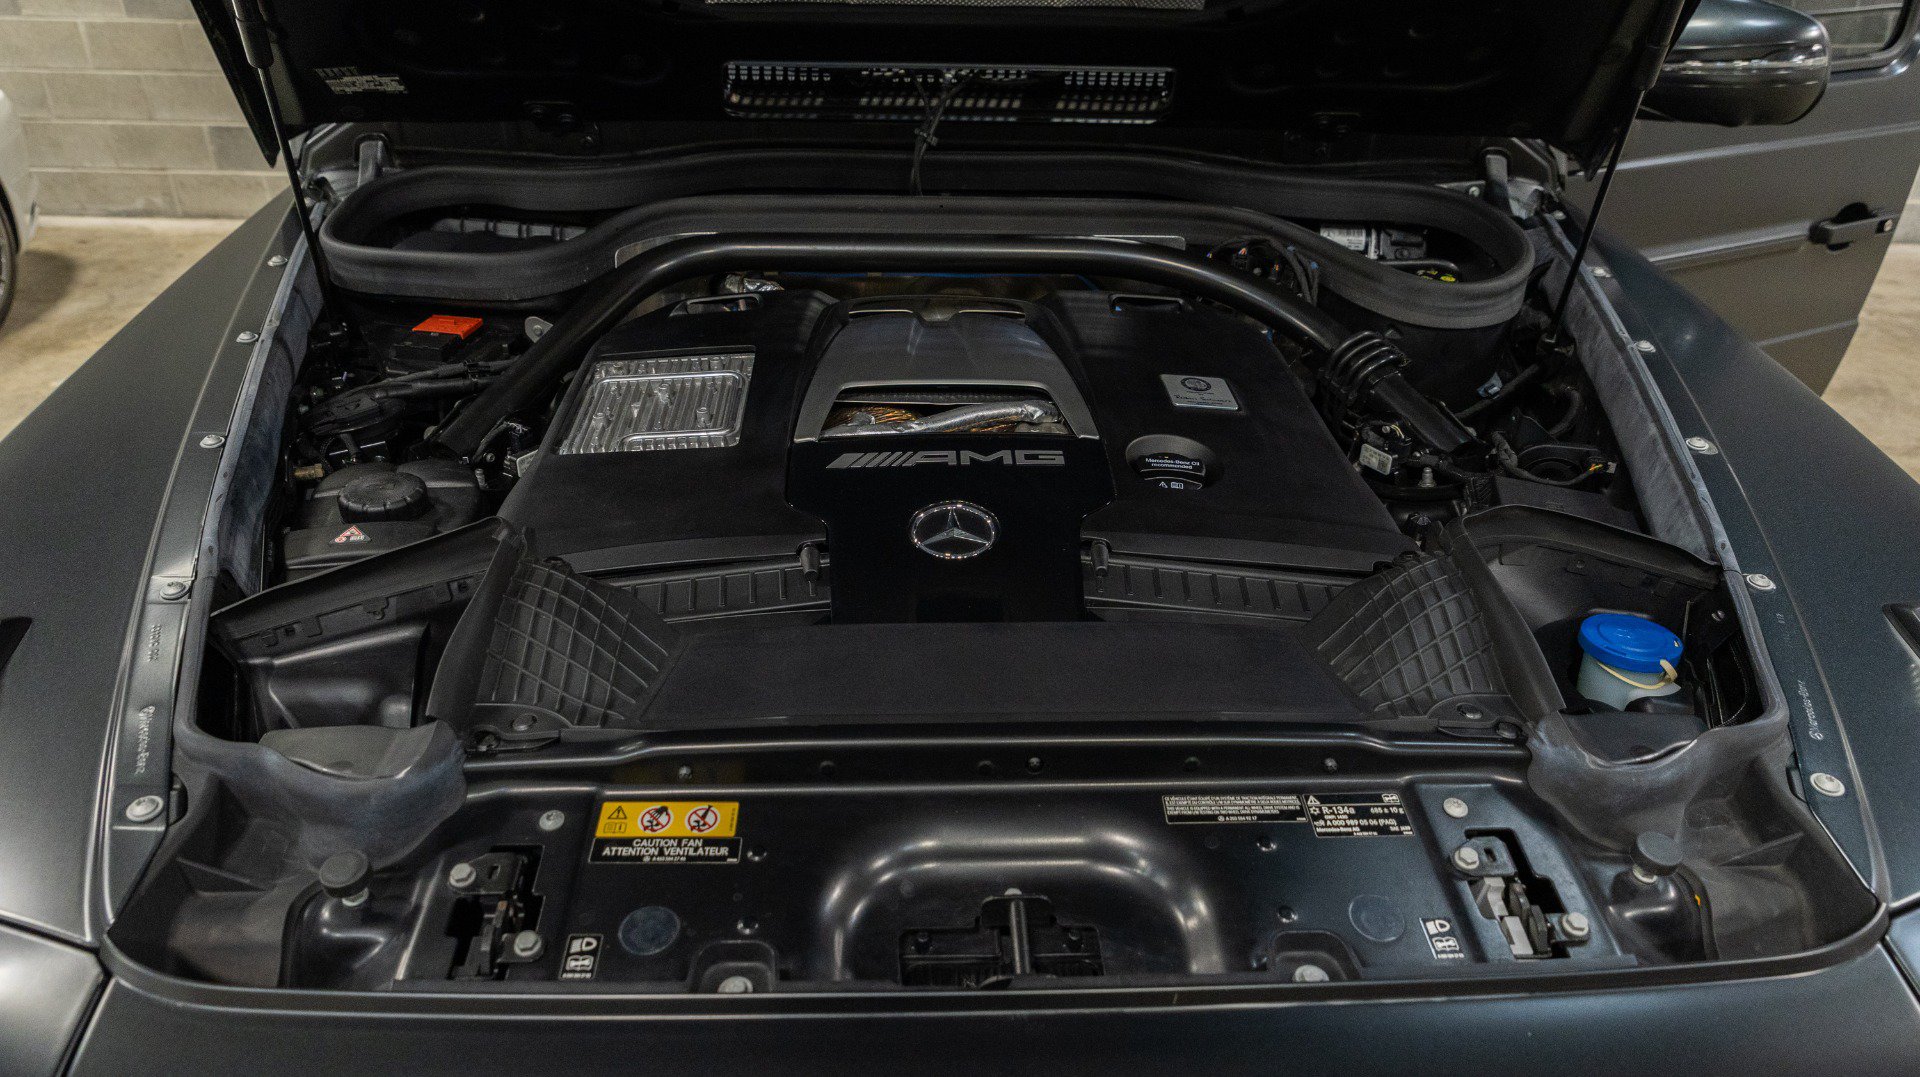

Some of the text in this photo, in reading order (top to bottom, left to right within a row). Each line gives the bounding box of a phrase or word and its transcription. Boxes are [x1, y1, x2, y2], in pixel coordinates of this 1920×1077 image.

[903, 450, 1065, 467] AMG
[1322, 806, 1356, 814] R-134a
[633, 838, 703, 847] CAUTION FAN
[602, 847, 729, 856] ATTENTION VENTILATEUR
